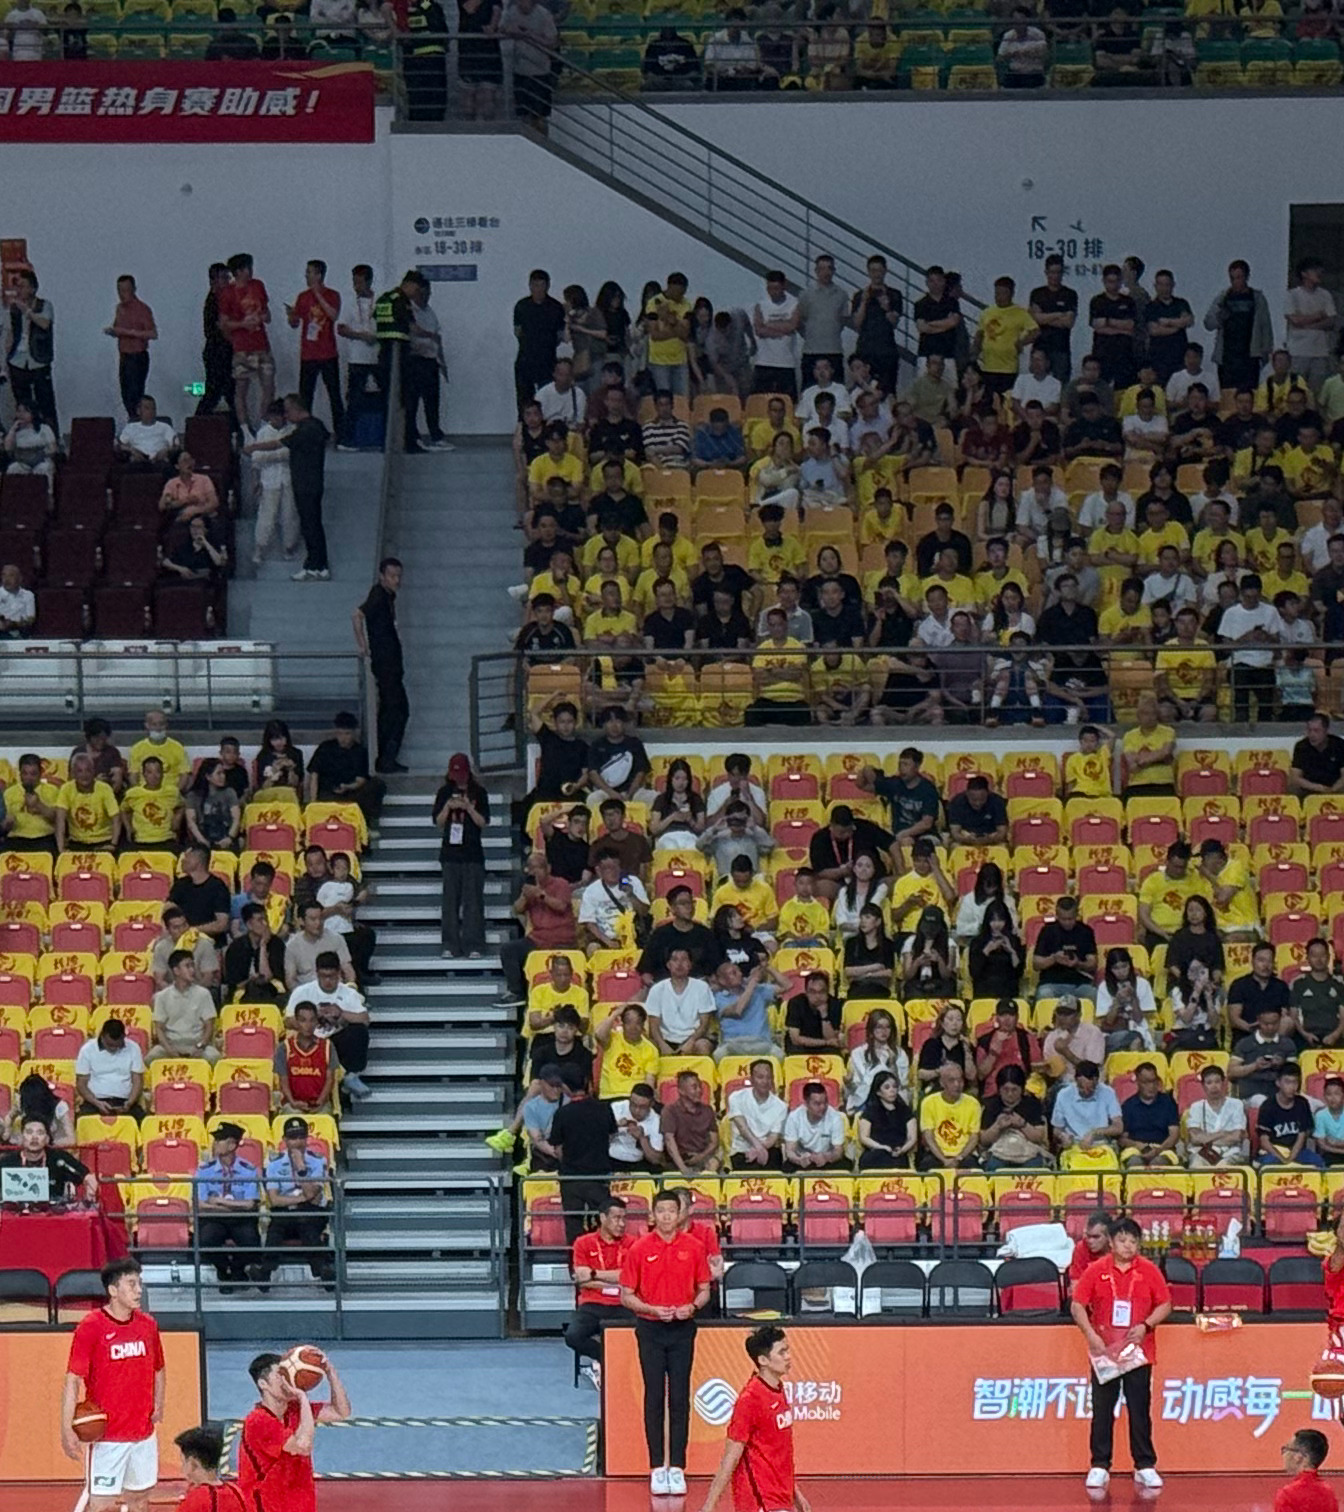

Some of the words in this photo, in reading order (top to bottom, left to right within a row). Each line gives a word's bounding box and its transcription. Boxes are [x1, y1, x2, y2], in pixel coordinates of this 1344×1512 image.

[1274, 1121, 1300, 1138] YAL
[110, 1340, 147, 1361] CHINA
[794, 1406, 841, 1420] Mobile
